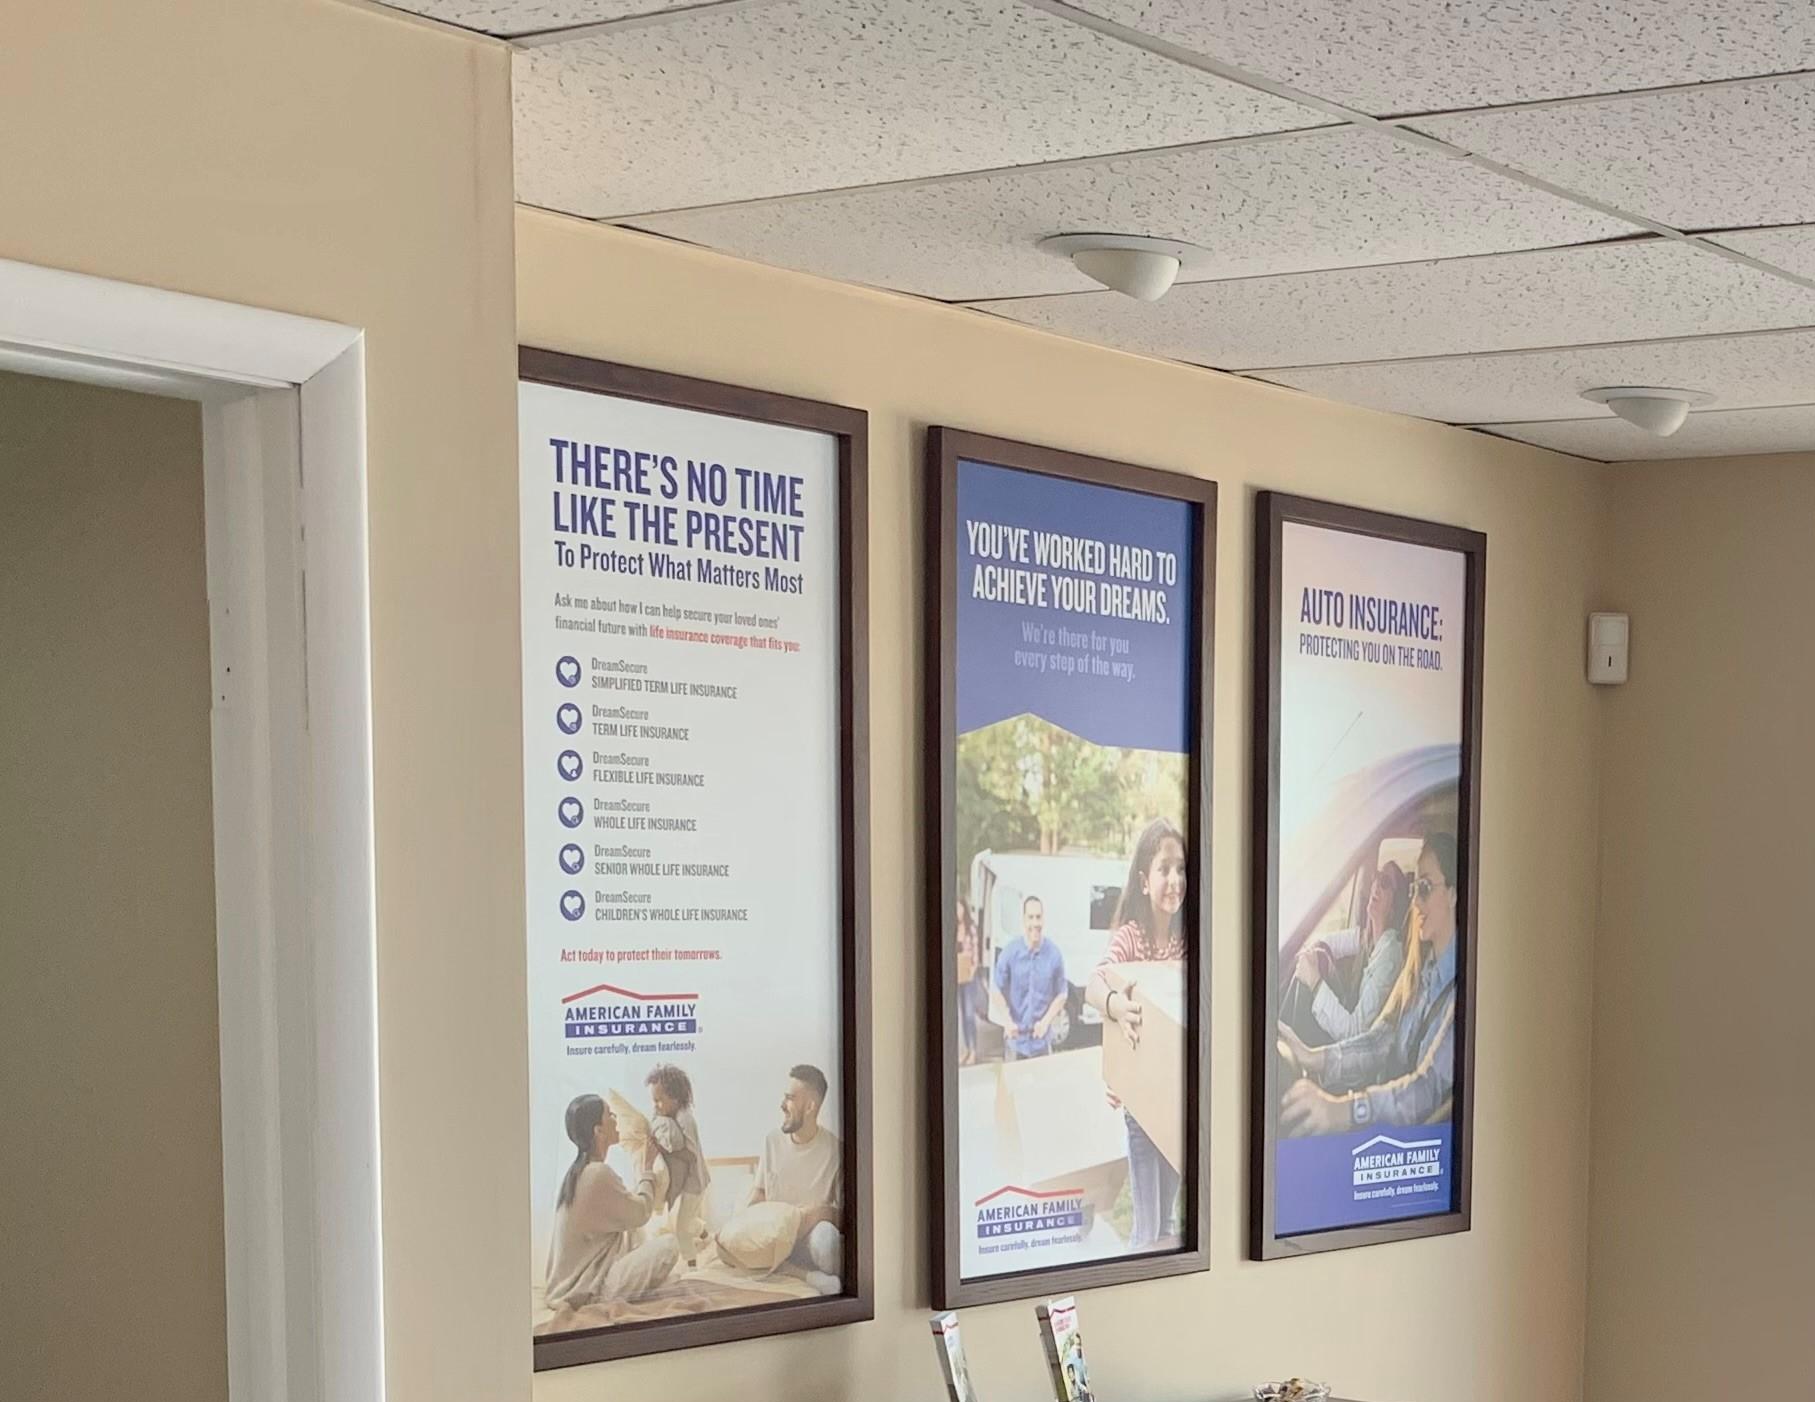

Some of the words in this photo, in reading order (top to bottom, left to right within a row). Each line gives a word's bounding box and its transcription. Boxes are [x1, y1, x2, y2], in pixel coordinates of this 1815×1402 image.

[550, 438, 678, 499] THERE'S
[688, 460, 727, 506] NO
[735, 468, 804, 517] TIME
[554, 491, 616, 538] LIKE
[624, 502, 678, 546] THE
[687, 511, 804, 561] PRESENT
[967, 520, 1030, 564] YOU'VE
[1034, 531, 1105, 575] WORKED
[1110, 543, 1152, 582] HARD
[1157, 551, 1177, 586] TO
[554, 540, 574, 567] To
[581, 544, 643, 576] Protect
[649, 552, 691, 581] What
[697, 558, 760, 589] Matters
[765, 566, 803, 594] Most
[972, 564, 1047, 607] ACHIEVE
[1051, 575, 1096, 614] YOUR
[1100, 583, 1170, 624] DREAMS.
[554, 592, 572, 608] Ask
[574, 598, 588, 609] me
[591, 597, 616, 612] about
[619, 599, 637, 614] how
[639, 600, 643, 614] I
[645, 604, 661, 616] can
[662, 603, 681, 620] help
[683, 609, 711, 623] secure
[713, 613, 732, 626] your
[735, 612, 756, 627] loved
[1300, 587, 1344, 628] AUTO
[1350, 593, 1443, 642] INSURANCE:
[555, 616, 595, 632] financial
[598, 619, 626, 635] future
[628, 622, 647, 637] with
[650, 624, 664, 639] life
[666, 628, 708, 643] insurance
[710, 634, 748, 649] coverage
[750, 635, 766, 649] that
[768, 636, 782, 650] fits
[1022, 620, 1055, 644] We're
[1058, 626, 1088, 649] there
[1091, 630, 1107, 651] for
[1109, 637, 1129, 656] you
[1299, 632, 1359, 662] PROTECTING
[1361, 641, 1380, 664] YOU
[1382, 643, 1395, 665] ON
[1397, 645, 1415, 668] THE
[1416, 648, 1443, 671] ROAD.
[591, 657, 647, 675] DreamSecure
[1014, 650, 1047, 673] every
[1050, 653, 1075, 676] step
[1077, 653, 1089, 673] of
[1092, 655, 1109, 675] the
[1111, 661, 1135, 682] way.
[591, 675, 642, 692] SIMPLIFIED
[644, 679, 668, 694] TERM
[670, 681, 688, 696] LIFE
[690, 682, 737, 699] INSURANCE
[592, 704, 648, 721] DreamSecure
[592, 722, 618, 737] TERM
[620, 725, 638, 738] LIFE
[640, 726, 689, 741] INSURANCE
[593, 751, 649, 767] DreamSecure
[593, 769, 634, 784] FLEXIBLE
[636, 772, 654, 785] LIFE
[656, 772, 704, 787] INSURANCE
[593, 798, 649, 813] DreamSecure
[594, 816, 626, 830] WHOLE
[628, 817, 646, 831] LIFE
[648, 818, 696, 832] INSURANCE
[594, 845, 650, 858] DreamSecure
[594, 862, 628, 876] SENIOR
[629, 863, 661, 876] WHOLE
[663, 864, 680, 876] LIFE
[682, 864, 729, 877] INSURANCE
[595, 891, 651, 904] DreamSecure
[595, 908, 648, 922] CHILDREN'S
[649, 908, 680, 921] WHOLE
[682, 908, 699, 921] LIFE
[701, 908, 748, 921] INSURANCE
[560, 949, 575, 962] Act
[579, 949, 603, 964] today
[606, 950, 615, 961] to
[617, 949, 650, 963] protect
[651, 948, 672, 961] their
[674, 949, 722, 961] tomorrows.
[565, 1005, 641, 1021] AMERICAN
[647, 1004, 696, 1018] FAMILY
[575, 1021, 687, 1036] INSURANCE
[1354, 1152, 1404, 1170] AMERICAN
[1407, 1148, 1440, 1164] FAMILY
[1360, 1165, 1433, 1181] INSURANCE
[977, 1203, 1038, 1222] AMERICAN
[1042, 1198, 1082, 1215] FAMILY
[985, 1215, 1076, 1235] INSURANCE
